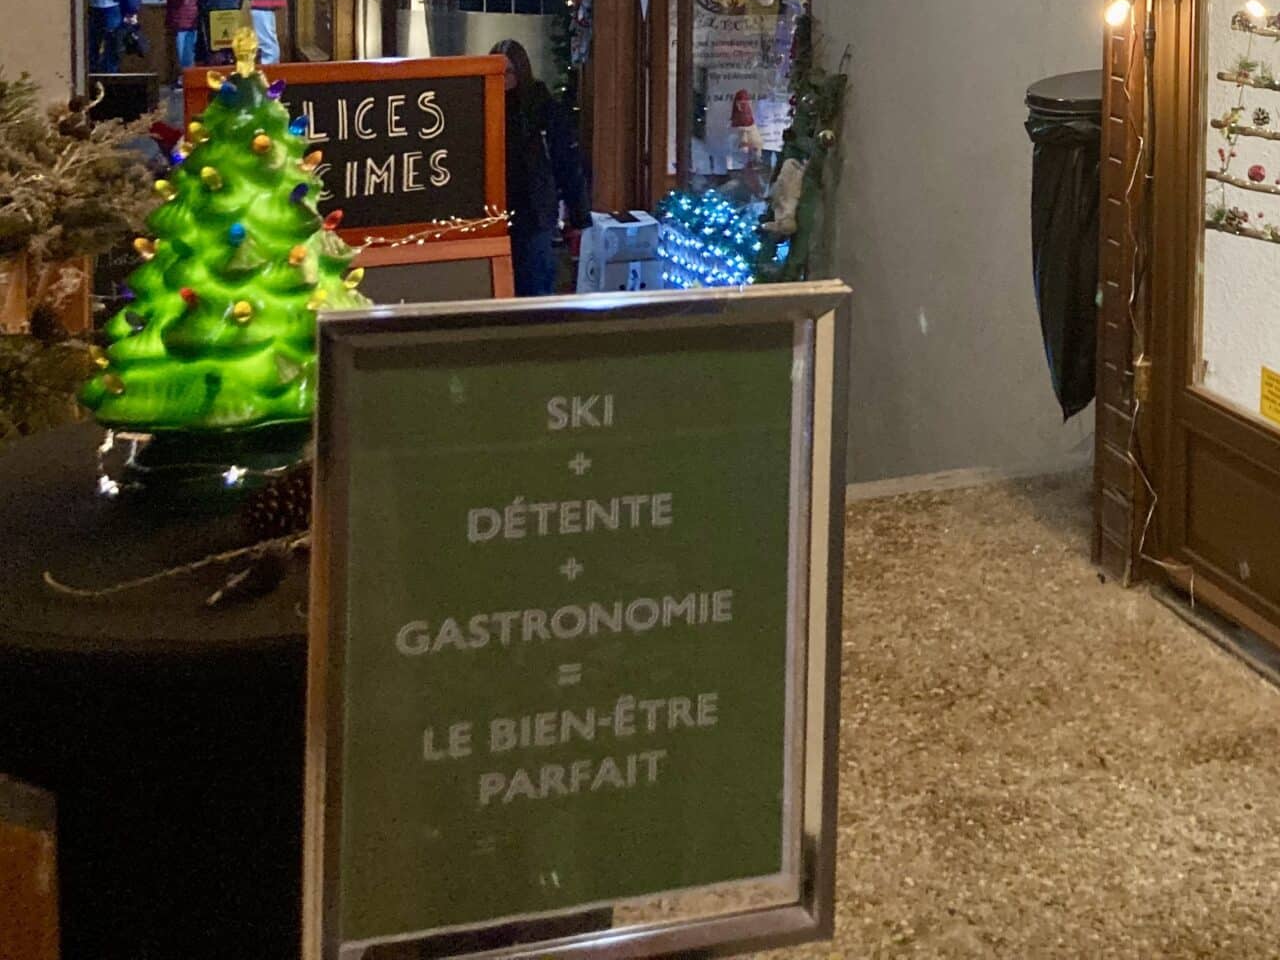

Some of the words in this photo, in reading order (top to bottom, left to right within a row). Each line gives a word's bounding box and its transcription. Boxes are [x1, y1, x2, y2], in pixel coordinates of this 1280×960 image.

[284, 91, 445, 143] LICES
[547, 394, 614, 431] SKI
[467, 493, 673, 544] DÉTENTE
[396, 590, 733, 656] GASTRONOMIE
[423, 721, 472, 762] LE
[489, 693, 719, 754] BIEN-ÊTRE
[479, 749, 668, 806] PARFAIT
